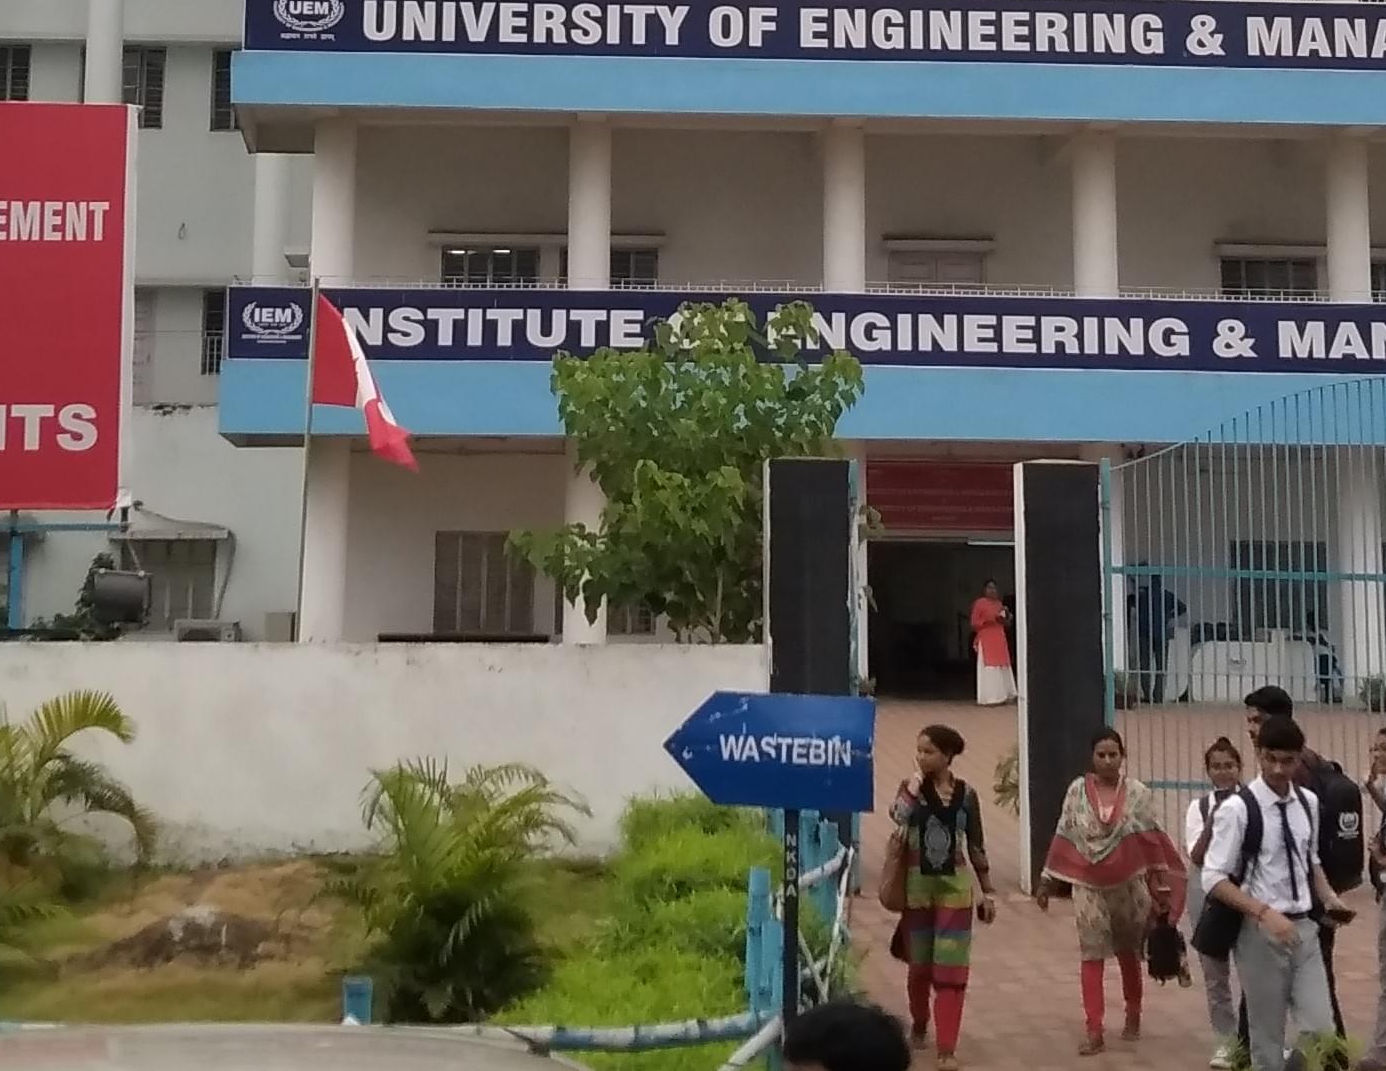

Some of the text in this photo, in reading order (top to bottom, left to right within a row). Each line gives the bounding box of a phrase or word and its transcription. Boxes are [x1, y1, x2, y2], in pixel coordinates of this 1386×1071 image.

[288, 0, 330, 15] UEM
[363, 0, 690, 46] UNIVERSITY
[708, 6, 778, 48] OF
[800, 8, 1164, 55] ENGINEERING
[1185, 14, 1226, 56] &
[253, 308, 292, 323] IEM
[342, 307, 645, 348] NSTITUTE
[1212, 319, 1258, 358] &
[719, 733, 852, 768] WASTEBIN
